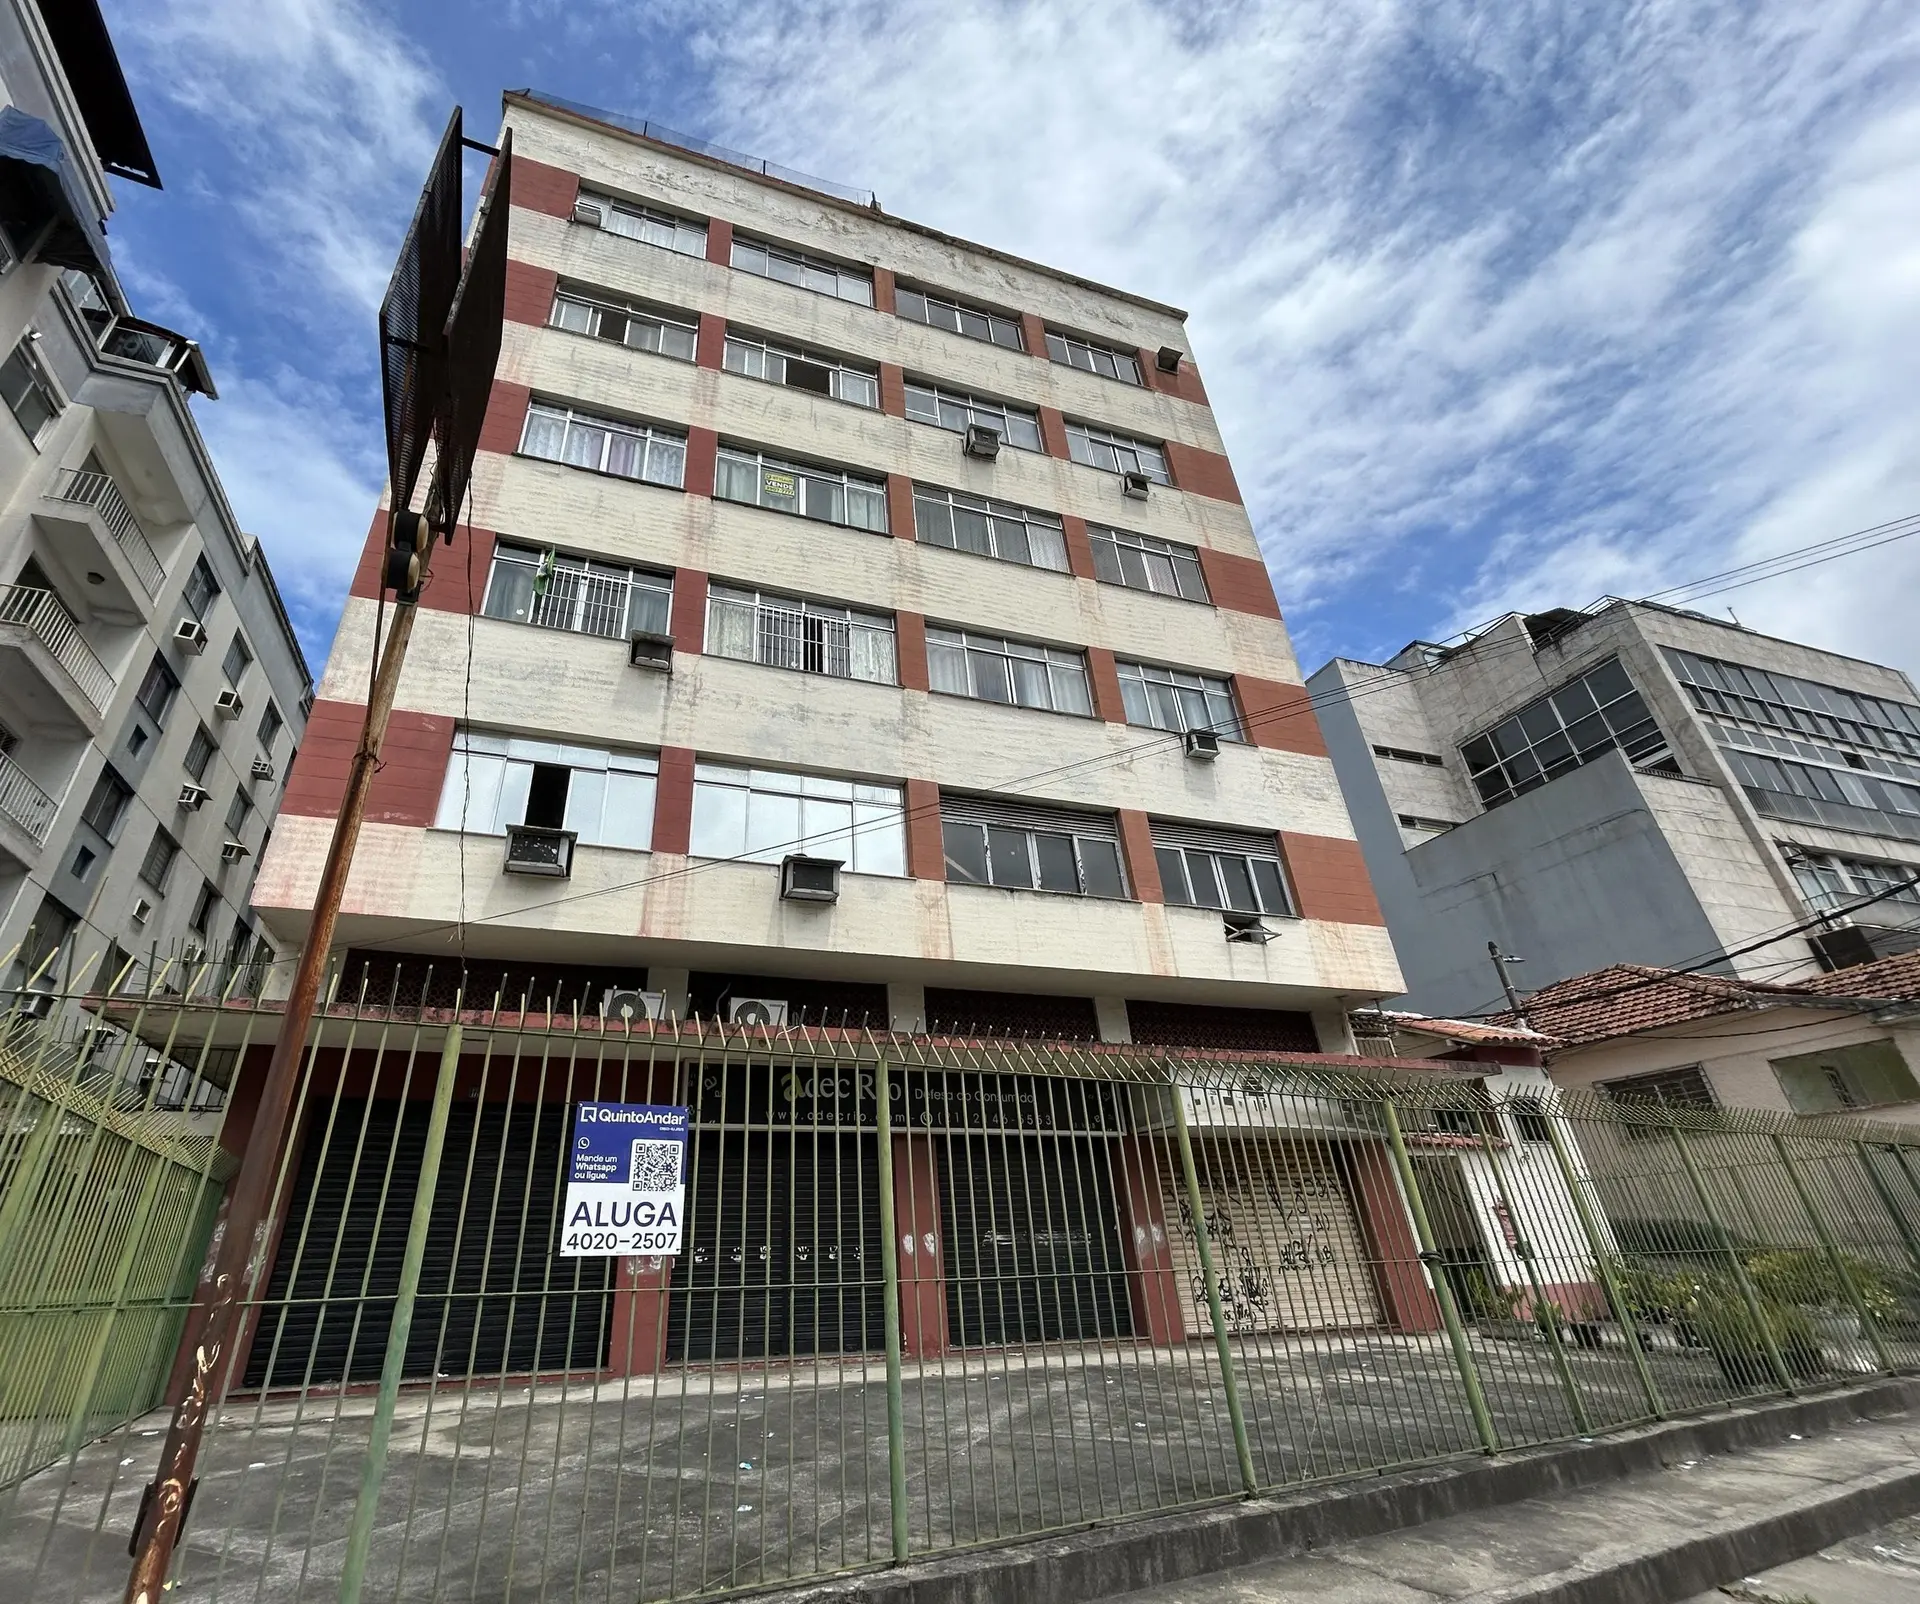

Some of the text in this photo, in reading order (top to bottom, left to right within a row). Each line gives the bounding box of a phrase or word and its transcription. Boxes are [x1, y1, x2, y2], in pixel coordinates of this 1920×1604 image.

[766, 480, 794, 490] VENDE
[859, 1073, 902, 1101] Ro
[974, 1090, 1036, 1103] Conumdo
[599, 1109, 685, 1125] QuintoAndar
[765, 1110, 906, 1122] www.adecrio.m
[576, 1154, 604, 1163] Mande
[575, 1163, 617, 1172] Whatsapp
[586, 1171, 608, 1181] ligue.
[569, 1201, 677, 1228] ALUGA
[566, 1233, 677, 1250] 4020-2507
